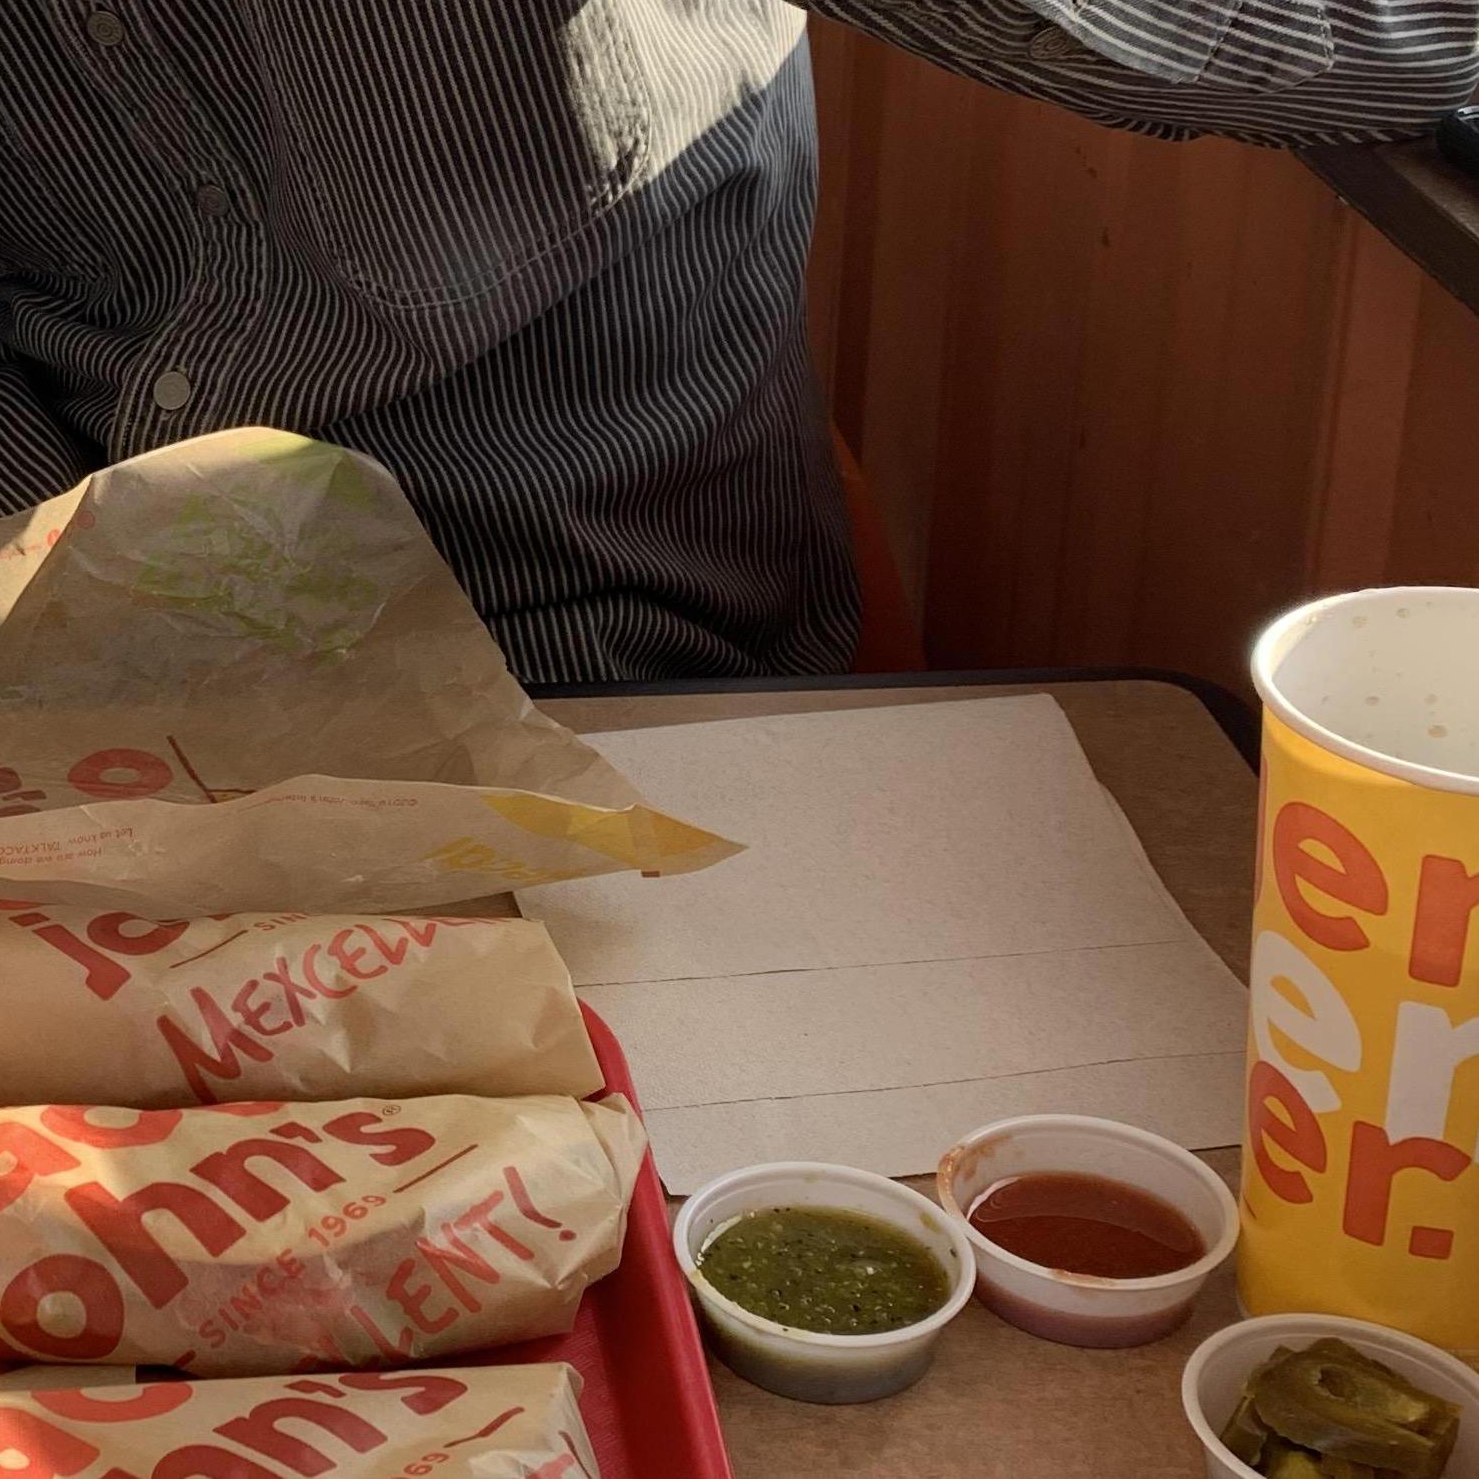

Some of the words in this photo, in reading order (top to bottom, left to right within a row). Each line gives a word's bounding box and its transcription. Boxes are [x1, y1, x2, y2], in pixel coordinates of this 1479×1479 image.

[78, 847, 103, 860] How
[156, 917, 512, 1105] MEXCELL
[198, 1248, 306, 1349] SINCE
[307, 1194, 387, 1248] 1969
